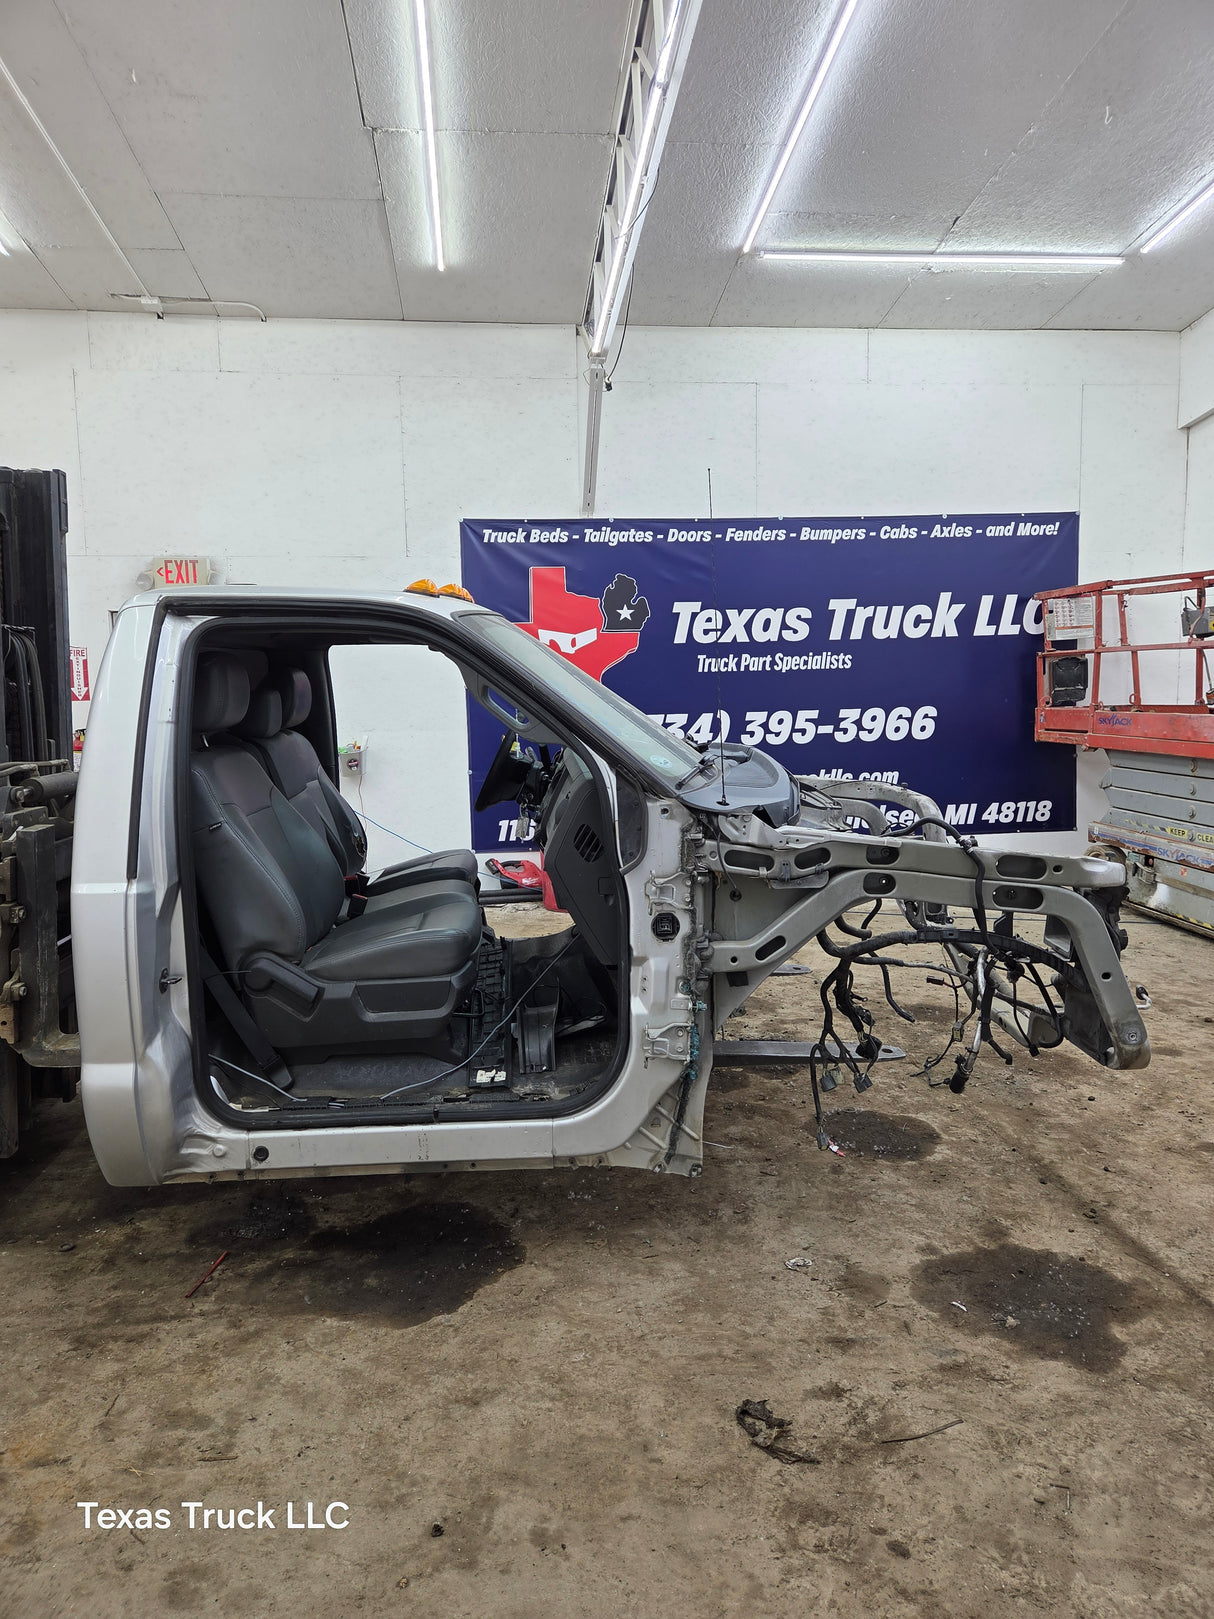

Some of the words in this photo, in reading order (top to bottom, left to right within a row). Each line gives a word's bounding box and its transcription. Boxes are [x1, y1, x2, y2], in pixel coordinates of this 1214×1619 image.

[483, 528, 527, 543] Truck
[529, 528, 569, 543] Beds
[584, 526, 653, 547] Tailgates
[667, 528, 712, 542] Doors
[725, 526, 787, 542] Fenders
[800, 526, 867, 544] Bumpers
[880, 524, 918, 540] Cabs
[930, 523, 972, 538] Axles
[985, 522, 1014, 537] and
[1017, 521, 1060, 536] More!
[164, 559, 199, 584] EXIT
[671, 601, 812, 644] Texas
[828, 592, 966, 641] Truck
[69, 649, 86, 657] FIRE
[697, 654, 738, 673] Truck
[740, 653, 772, 671] Part
[774, 652, 853, 673] Specialists
[741, 705, 938, 746] 395-3966
[1098, 713, 1133, 727] SKYJACK
[945, 803, 977, 826] MI
[981, 800, 1053, 824] 48118
[1170, 827, 1186, 837] KEEP
